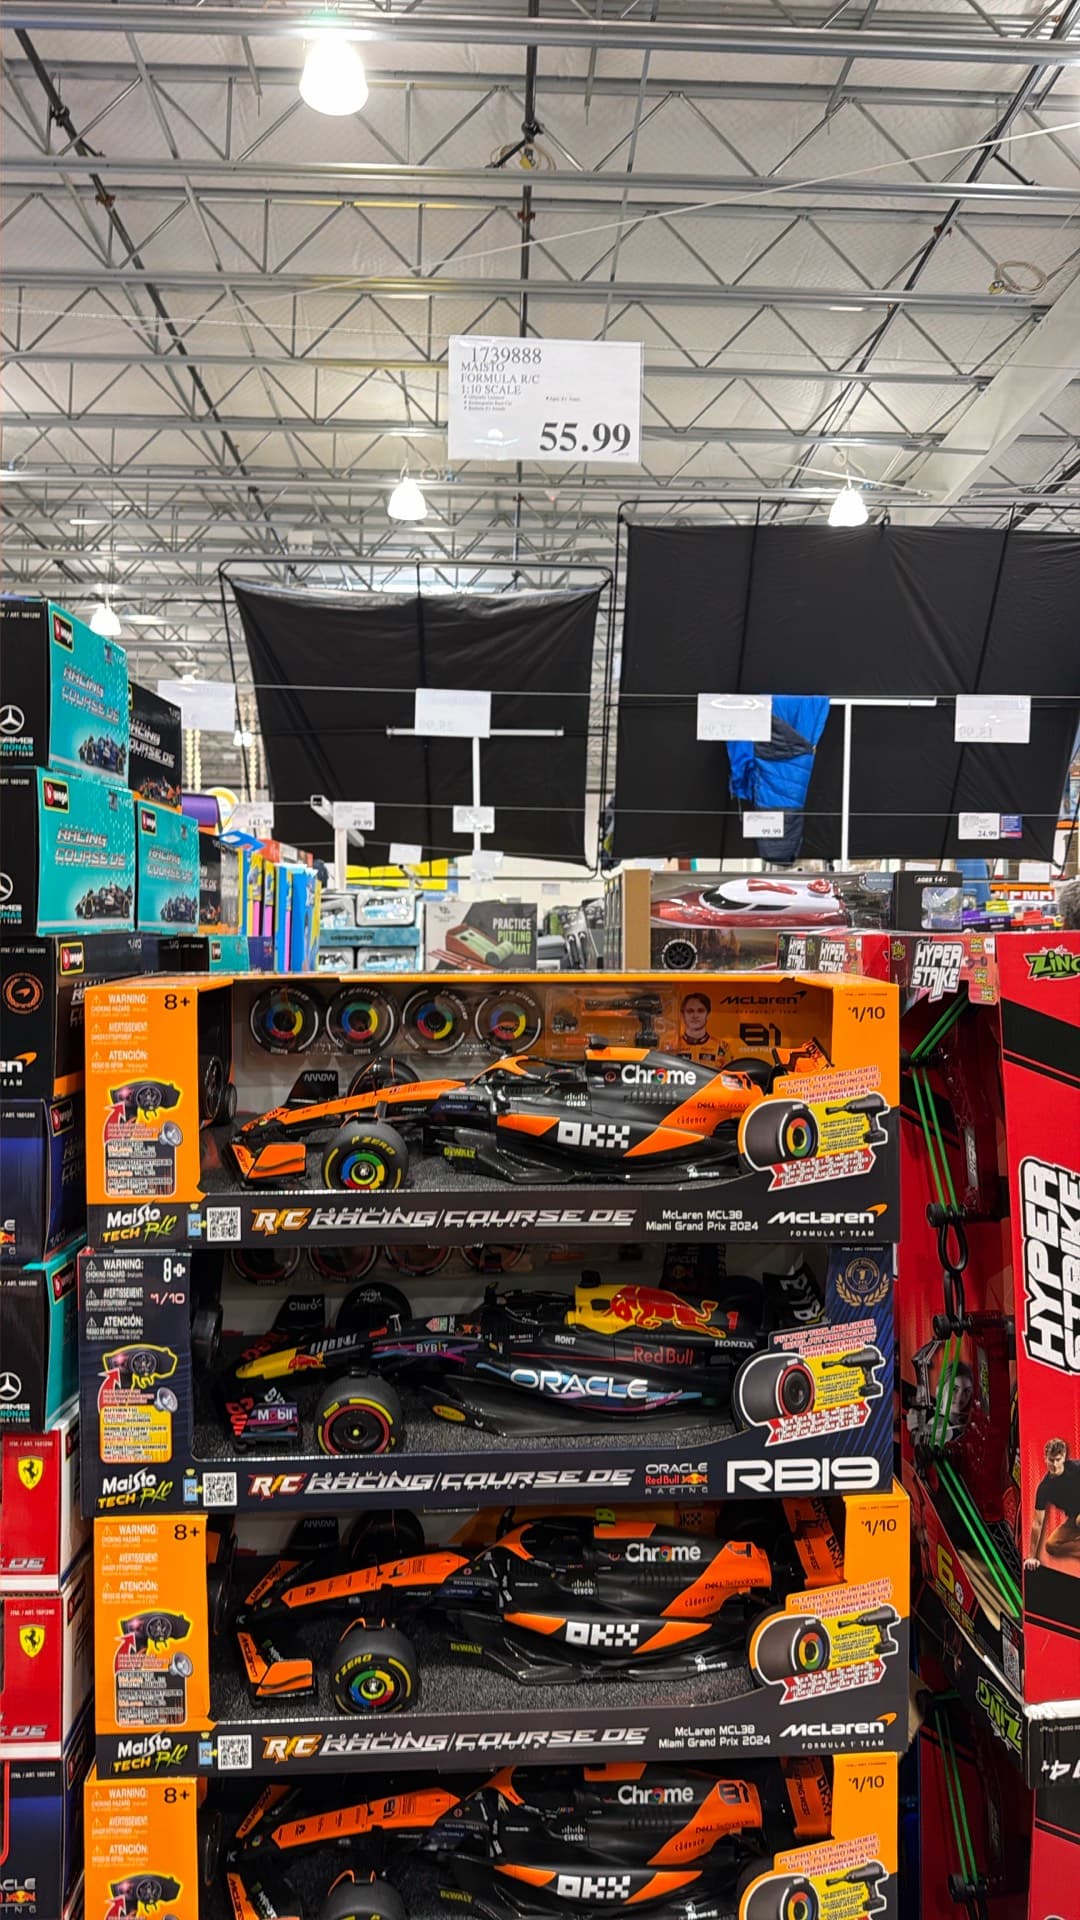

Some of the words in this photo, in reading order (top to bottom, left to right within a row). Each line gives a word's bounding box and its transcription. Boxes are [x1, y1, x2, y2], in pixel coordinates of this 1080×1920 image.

[471, 346, 542, 364] 1739888
[461, 362, 505, 373] MAISTO
[461, 373, 517, 384] FORMULA
[521, 374, 540, 385] R/C
[462, 384, 482, 394] 1:10
[484, 385, 522, 395] SCALE
[539, 421, 631, 453] 55.99
[57, 829, 107, 848] RACING
[55, 848, 110, 866] COURSE
[492, 918, 532, 930] PRACTICE
[497, 930, 532, 943] PUTTING
[513, 943, 531, 955] MAT
[820, 942, 846, 961] HYPER
[914, 943, 963, 967] HYPER
[912, 966, 959, 996] STRIKE
[108, 993, 149, 1004] WARNING:
[164, 993, 190, 1010] 8+
[720, 995, 797, 1005] McLaren
[849, 1006, 885, 1023] 1/10
[620, 1064, 696, 1085] Chrome
[557, 1120, 630, 1149] OKX
[107, 1203, 161, 1229] Maisto
[254, 1208, 310, 1234] R/C
[589, 1209, 637, 1224] DE
[662, 1209, 703, 1220] McLaren
[706, 1209, 743, 1220] MCL38
[767, 1211, 875, 1224] McLaren
[646, 1221, 672, 1231] Miami
[674, 1221, 704, 1231] Grand
[706, 1220, 726, 1231] Prix
[730, 1221, 759, 1231] 2024
[103, 1228, 141, 1242] TECH
[103, 1258, 144, 1270] WARNING:
[1023, 1160, 1066, 1367] HYPER
[103, 1314, 144, 1327] ATENCIÓN:
[714, 1339, 755, 1348] HONDA
[632, 1347, 664, 1363] Red
[665, 1348, 694, 1364] Bull
[509, 1369, 648, 1399] ORACLE
[257, 1409, 294, 1421] Mobil
[645, 1463, 708, 1474] ORACLE
[727, 1456, 880, 1494] RB19
[102, 1469, 156, 1495] Maisto
[250, 1474, 305, 1499] R/C
[587, 1468, 635, 1483] DE
[645, 1474, 662, 1485] Red
[662, 1474, 680, 1485] Bull
[645, 1486, 709, 1495] RACING
[98, 1494, 136, 1508] TECH
[118, 1524, 159, 1535] WARNING:
[173, 1524, 200, 1540] 8+
[861, 1518, 897, 1536] 1/10
[625, 1543, 701, 1562] Chrome
[9, 1557, 46, 1569] DE
[565, 1621, 639, 1647] OKX
[10, 1724, 47, 1736] DE
[674, 1725, 716, 1737] McLaren
[719, 1724, 755, 1735] MCL38
[779, 1722, 884, 1737] McLaren
[117, 1732, 172, 1758] Maisto
[264, 1735, 320, 1761] R/C
[602, 1728, 649, 1743] DE
[658, 1737, 685, 1749] Miami
[687, 1736, 717, 1748] Grand
[720, 1735, 739, 1746] Prix
[742, 1735, 771, 1746] 2024
[801, 1741, 847, 1749] FORMULA
[112, 1758, 151, 1773] TECH
[849, 1774, 885, 1792] 1/10
[108, 1789, 149, 1799] WARNING:
[164, 1788, 190, 1804] 8+
[617, 1784, 694, 1806] Chrome
[556, 1874, 631, 1899] OKX
